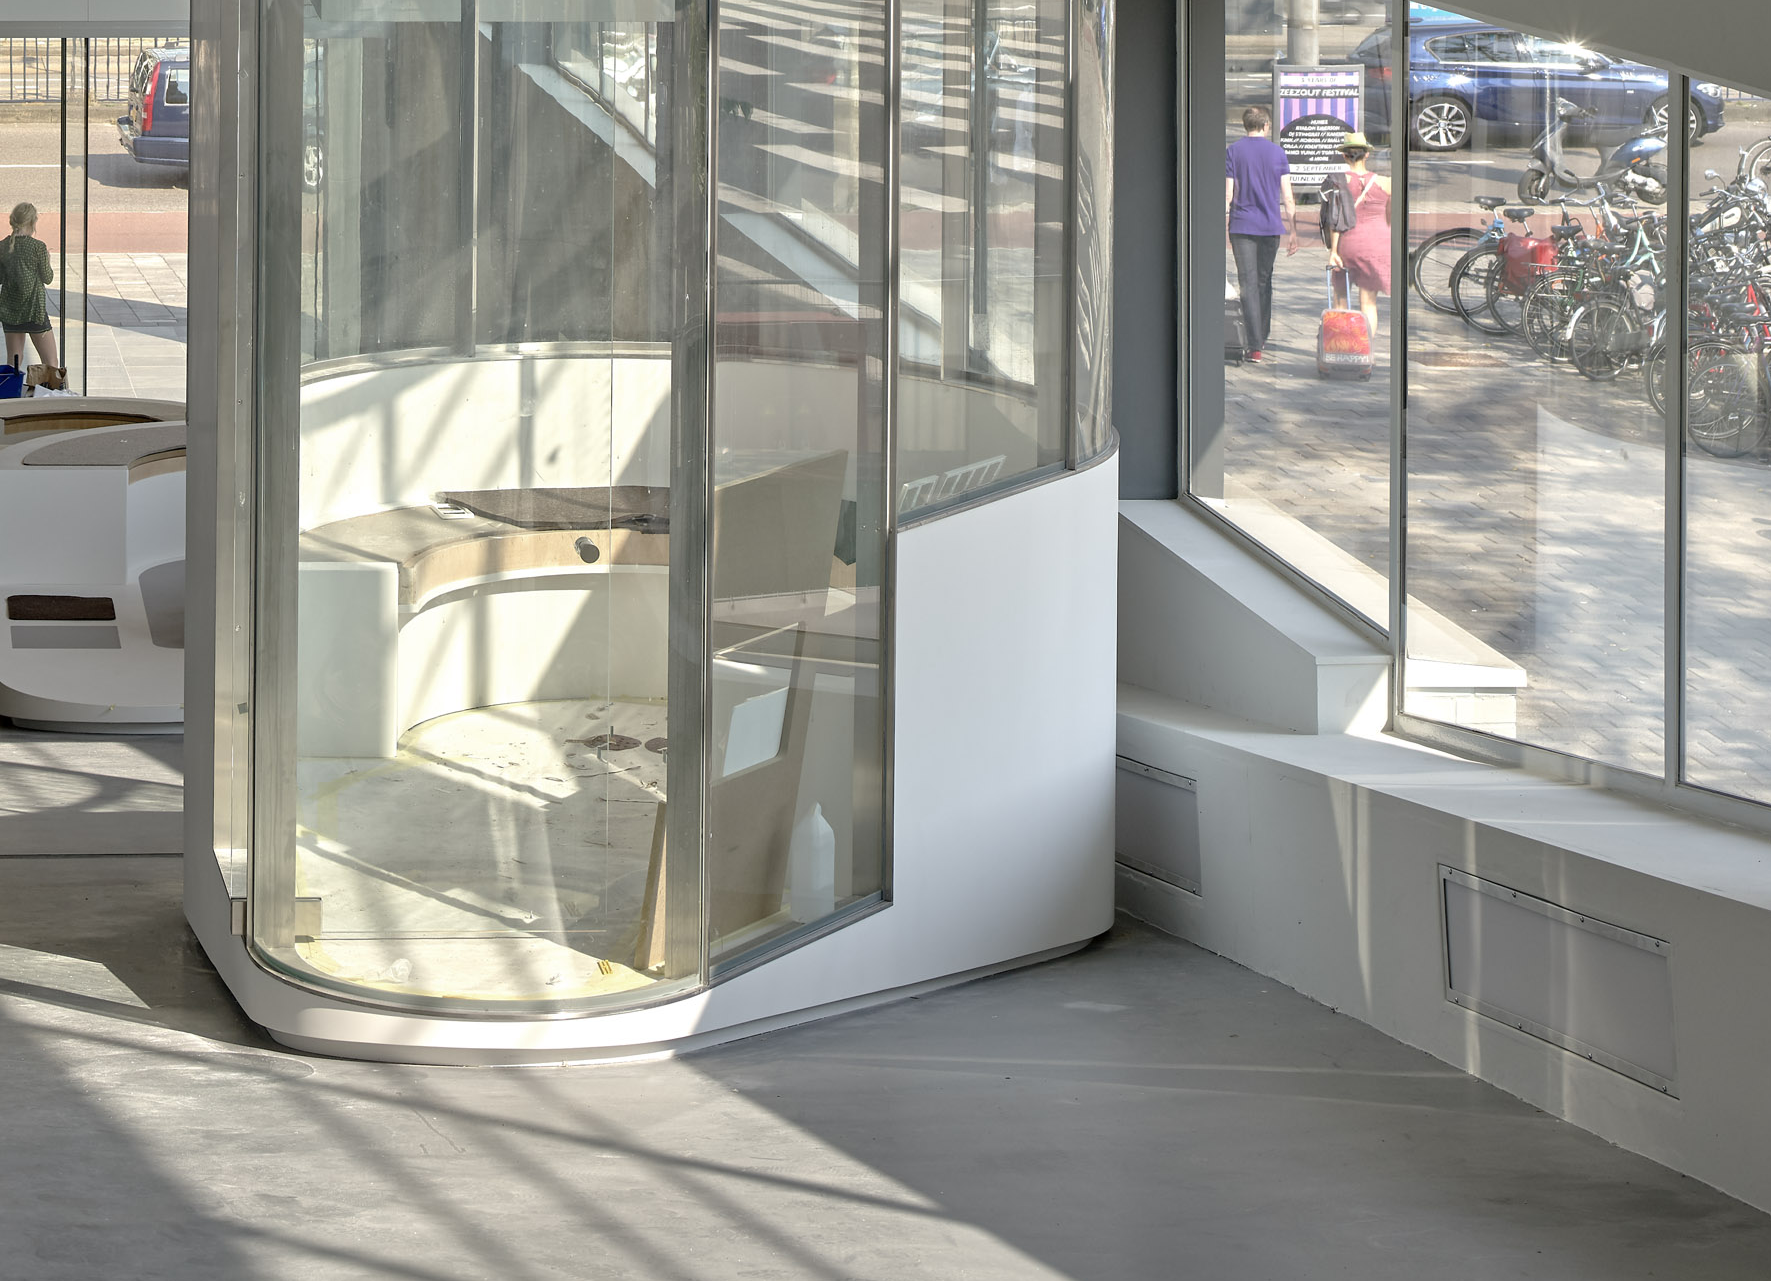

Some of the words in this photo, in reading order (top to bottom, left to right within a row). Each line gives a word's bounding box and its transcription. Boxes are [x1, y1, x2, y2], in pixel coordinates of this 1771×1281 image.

[1280, 88, 1321, 97] ZEEZOUT
[1322, 88, 1359, 97] FESTIVAL
[1325, 353, 1336, 361] BE
[1337, 353, 1369, 363] HAPPY!
